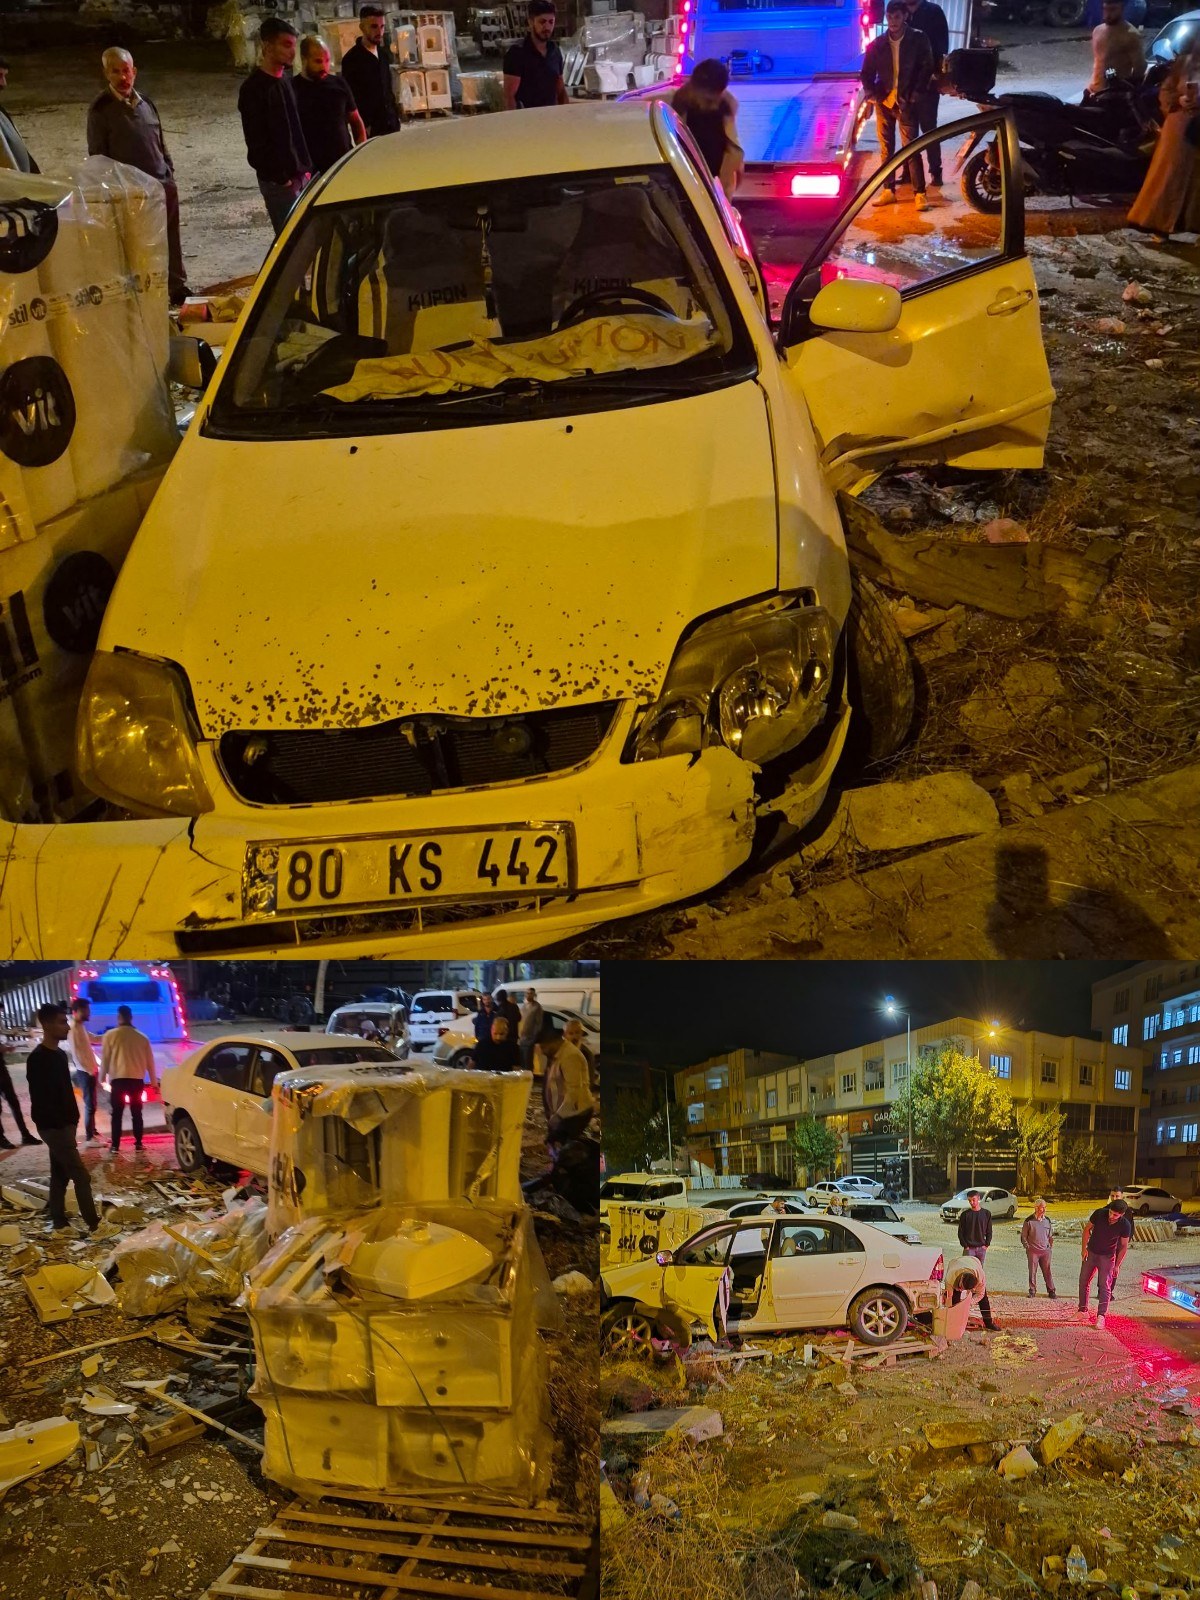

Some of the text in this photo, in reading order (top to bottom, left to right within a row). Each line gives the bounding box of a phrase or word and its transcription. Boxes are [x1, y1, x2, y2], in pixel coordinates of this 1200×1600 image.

[9, 304, 29, 326] stil
[32, 302, 46, 319] vit
[12, 388, 61, 435] vit
[287, 848, 343, 902] 80
[388, 841, 442, 895] KS
[477, 835, 558, 887] 442
